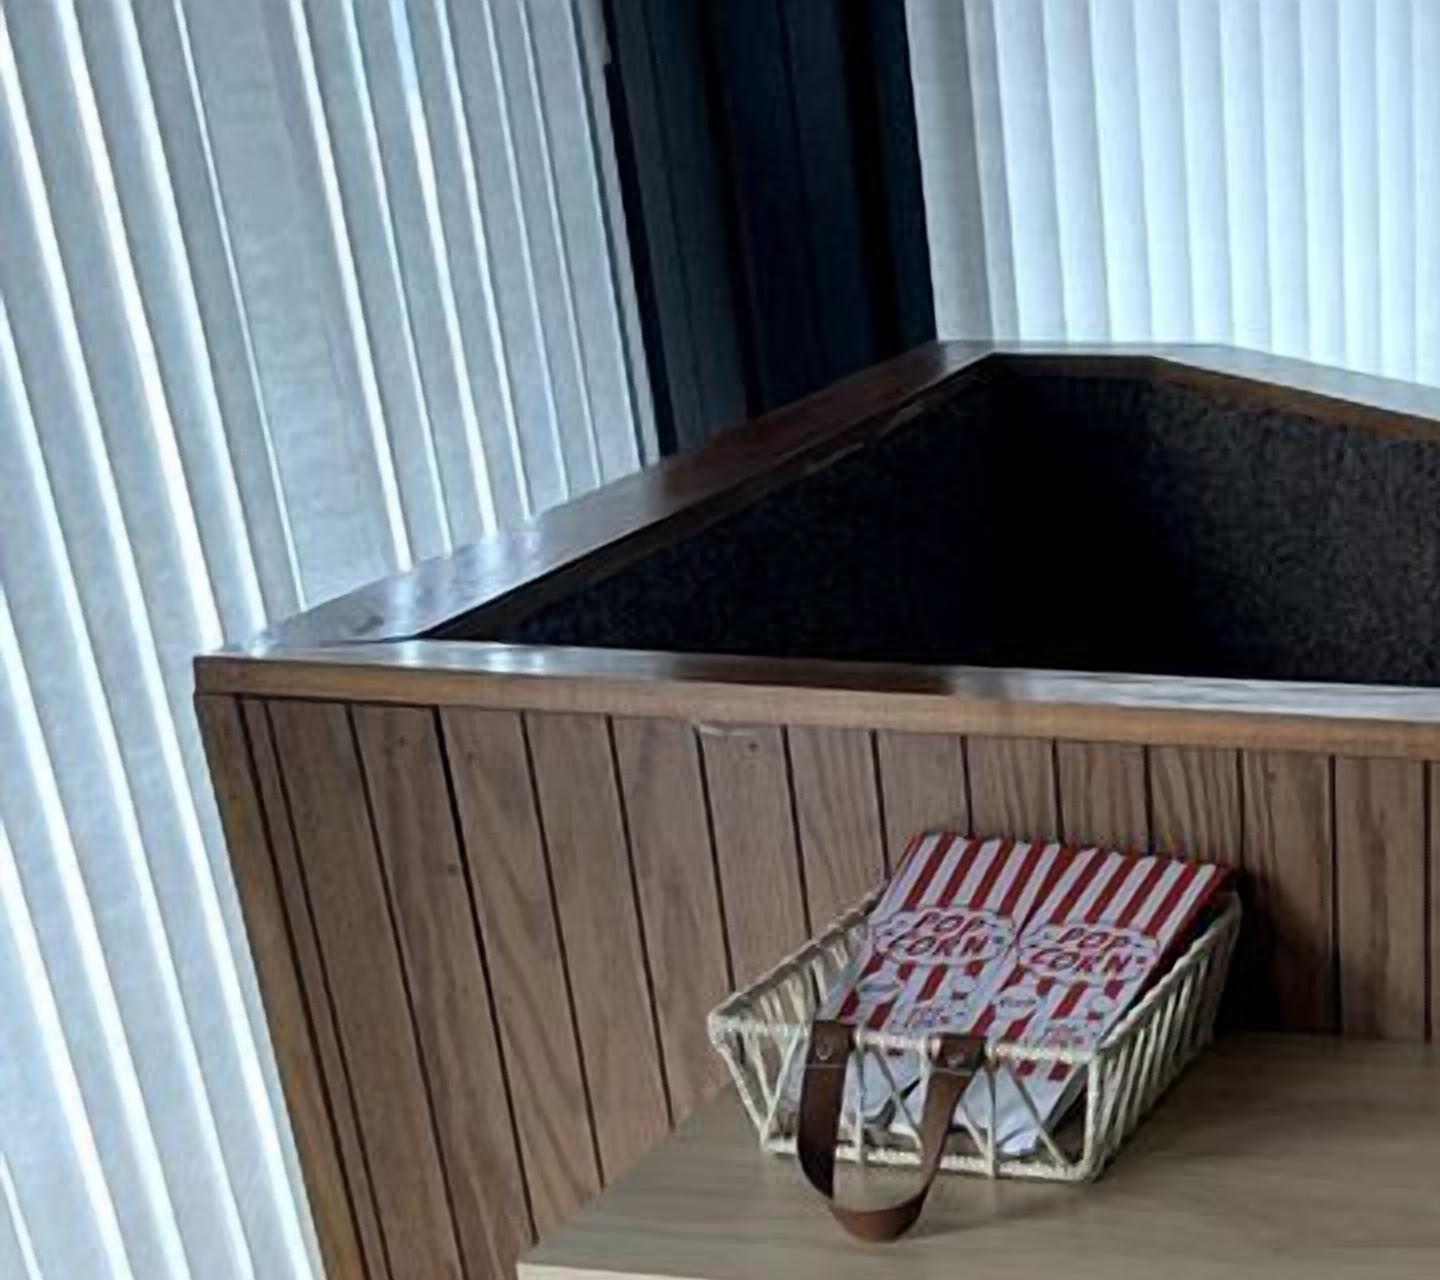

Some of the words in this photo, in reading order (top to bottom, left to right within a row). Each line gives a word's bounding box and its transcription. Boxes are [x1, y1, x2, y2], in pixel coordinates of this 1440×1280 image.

[888, 931, 990, 960] CORN
[1057, 927, 1130, 951] POP
[1029, 947, 1134, 976] CORN
